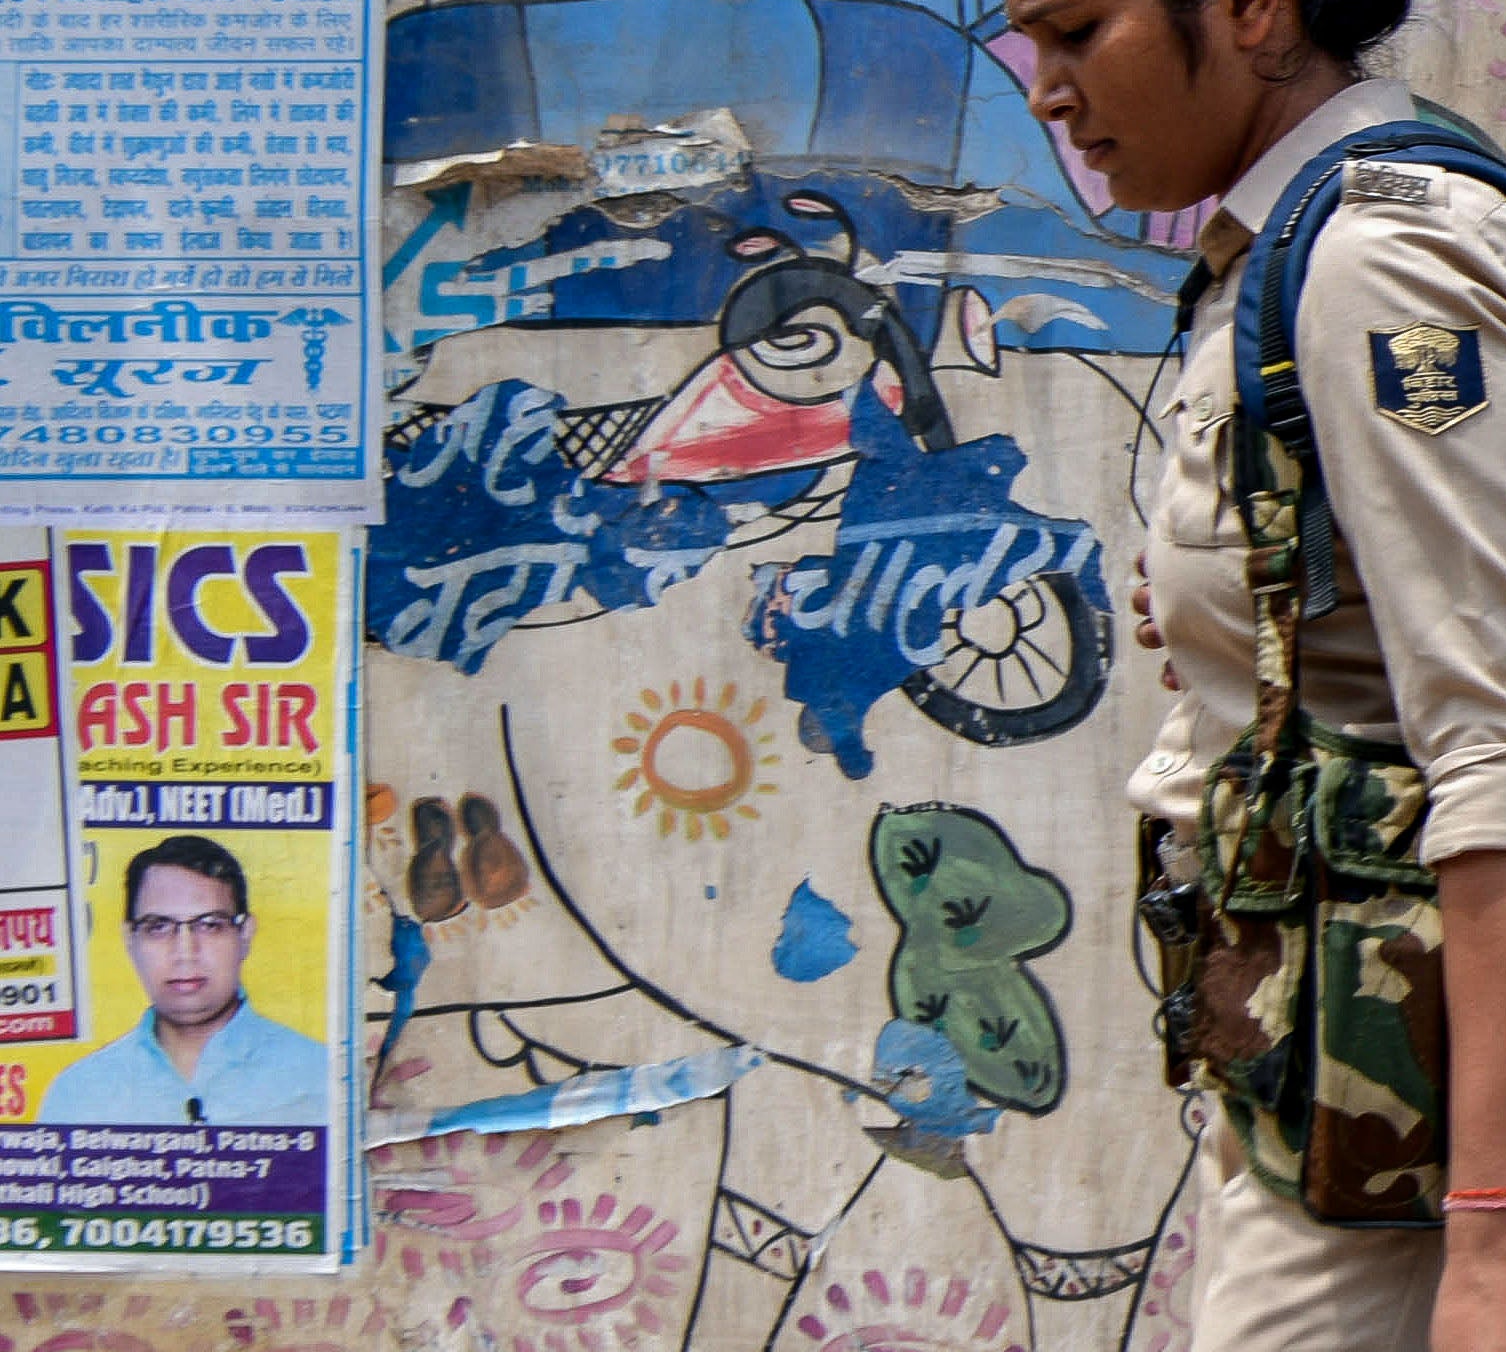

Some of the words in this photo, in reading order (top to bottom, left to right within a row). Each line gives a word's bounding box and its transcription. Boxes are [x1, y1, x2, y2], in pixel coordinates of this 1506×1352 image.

[50, 358, 274, 399] सूरज
[77, 681, 198, 754] ASH
[221, 681, 320, 755] SIR
[172, 756, 322, 776] Experience)
[160, 785, 227, 824] NEET
[58, 1218, 315, 1249] 7004179536
